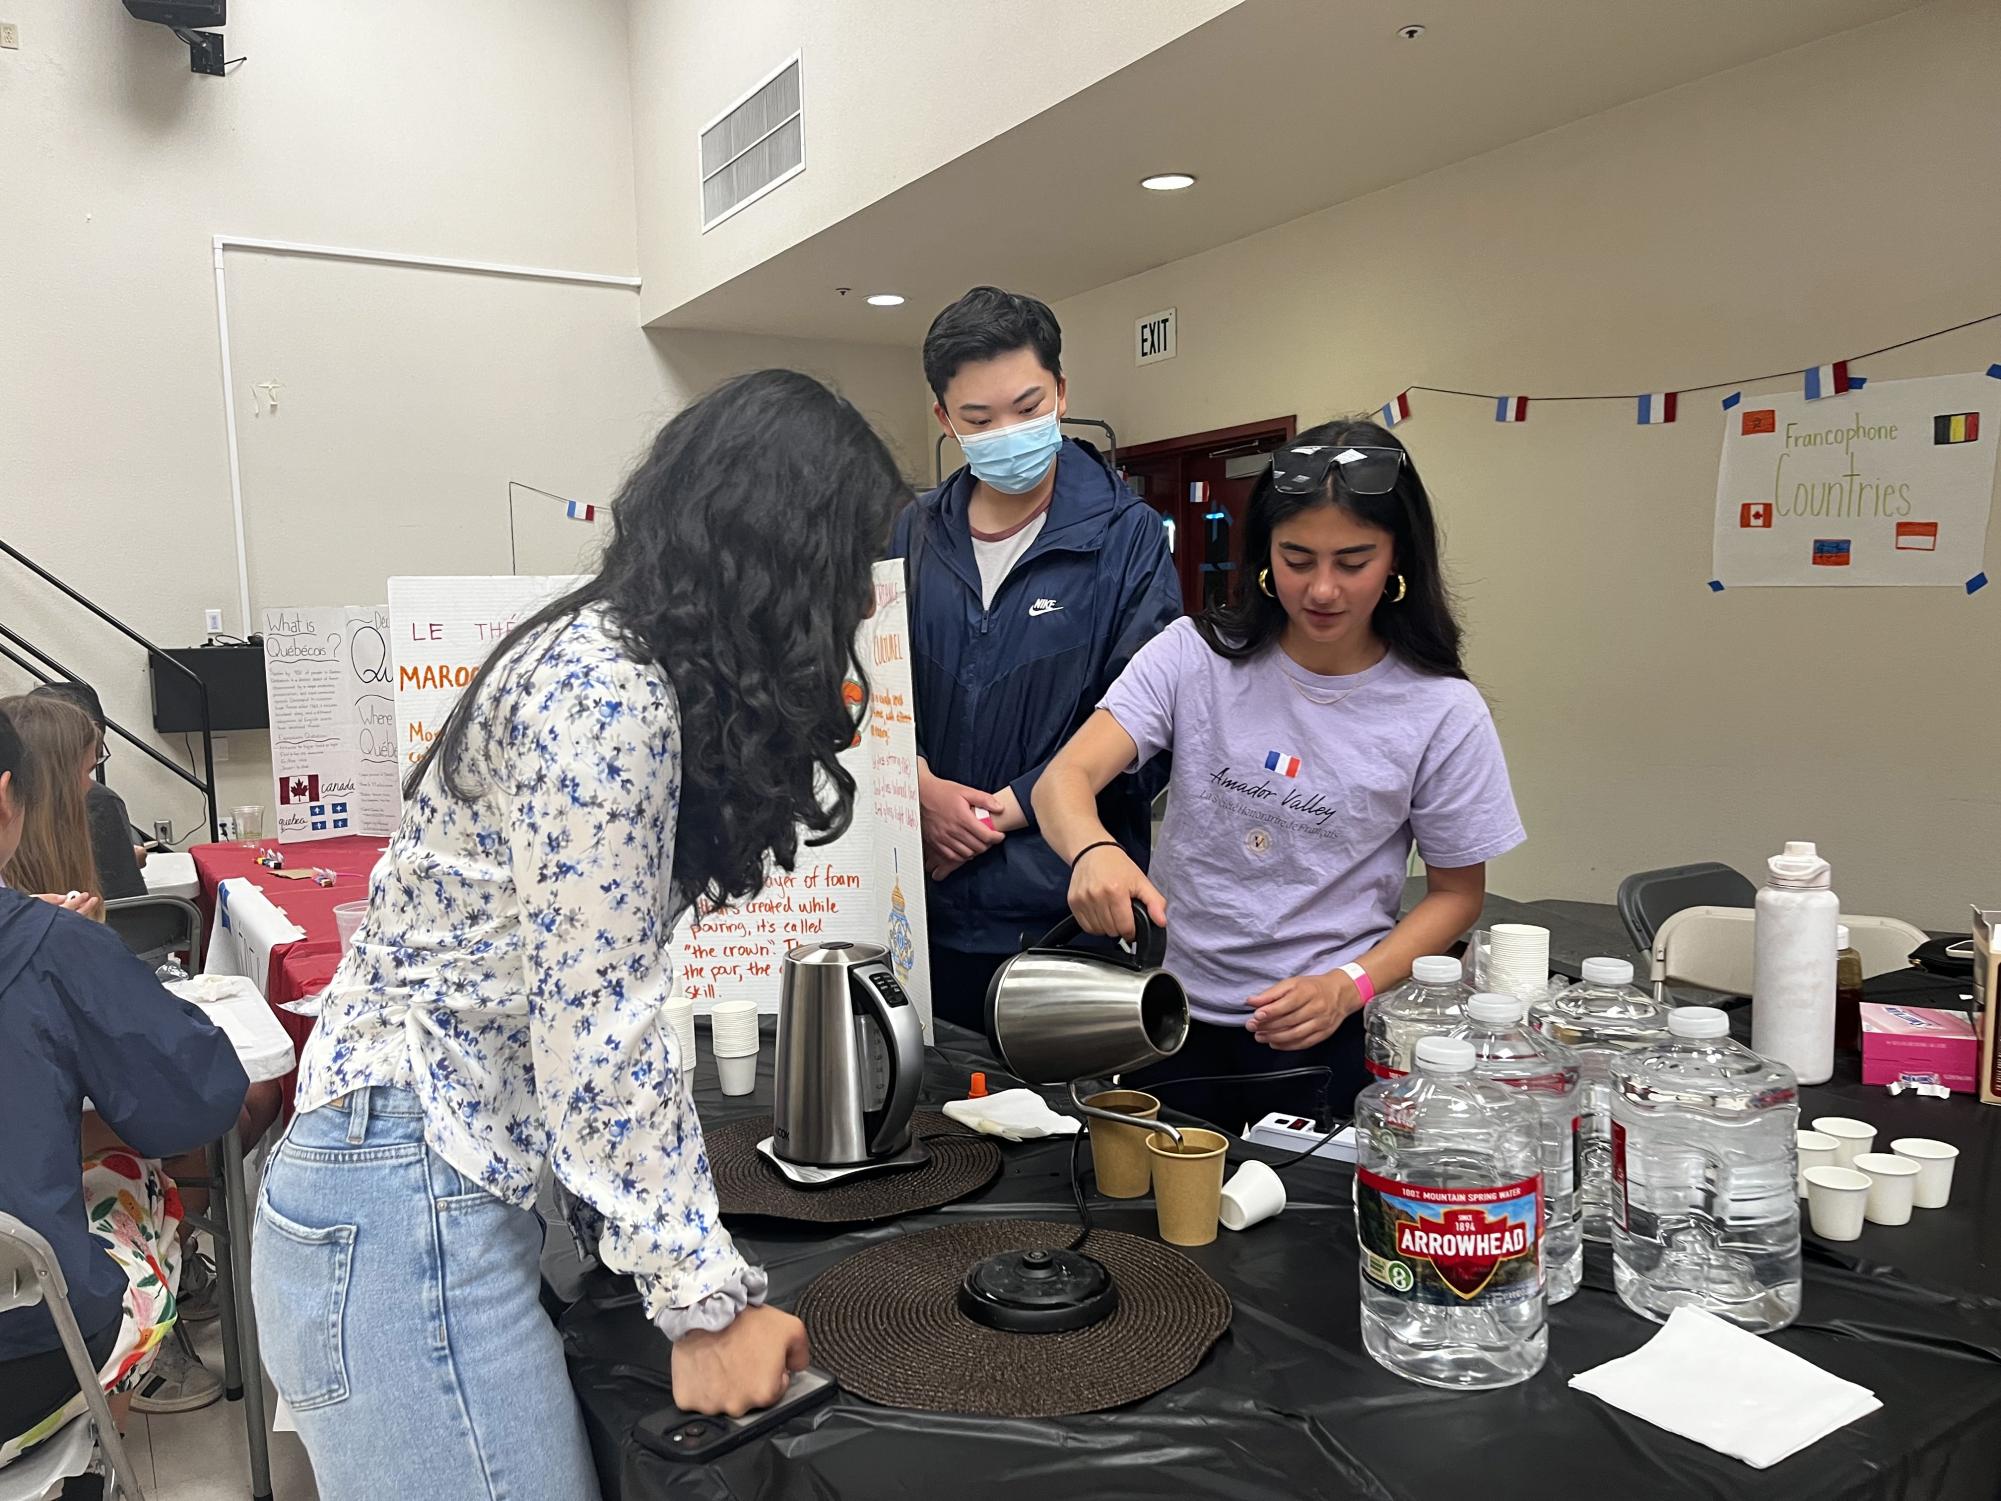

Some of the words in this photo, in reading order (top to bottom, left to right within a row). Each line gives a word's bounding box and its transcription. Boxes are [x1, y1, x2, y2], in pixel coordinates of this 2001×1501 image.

[1141, 318, 1169, 357] EXIT
[1786, 412, 1898, 455] Francophone
[1775, 452, 1911, 518] Countries
[1033, 598, 1057, 610] NIKE
[267, 613, 302, 632] What
[306, 620, 315, 632] is
[412, 622, 444, 641] LE
[358, 704, 393, 725] Where
[321, 778, 355, 793] canada
[1210, 767, 1277, 800] Amador
[1280, 788, 1337, 825] Valley
[764, 872, 797, 898] ayer
[804, 865, 820, 889] of
[824, 864, 860, 889] foam
[746, 897, 794, 914] created
[799, 897, 839, 914] while
[690, 919, 752, 940] pouring,
[757, 920, 776, 933] it's
[784, 918, 824, 934] called
[683, 965, 704, 981] the
[710, 964, 743, 983] pour,
[746, 961, 770, 977] the
[685, 984, 723, 999] skill.
[1423, 1191, 1467, 1202] MOUNTAIN
[1468, 1192, 1497, 1202] SPRING
[1499, 1187, 1521, 1199] WATER
[1455, 1221, 1476, 1232] 1894
[1401, 1228, 1524, 1257] ARROWHEAD
